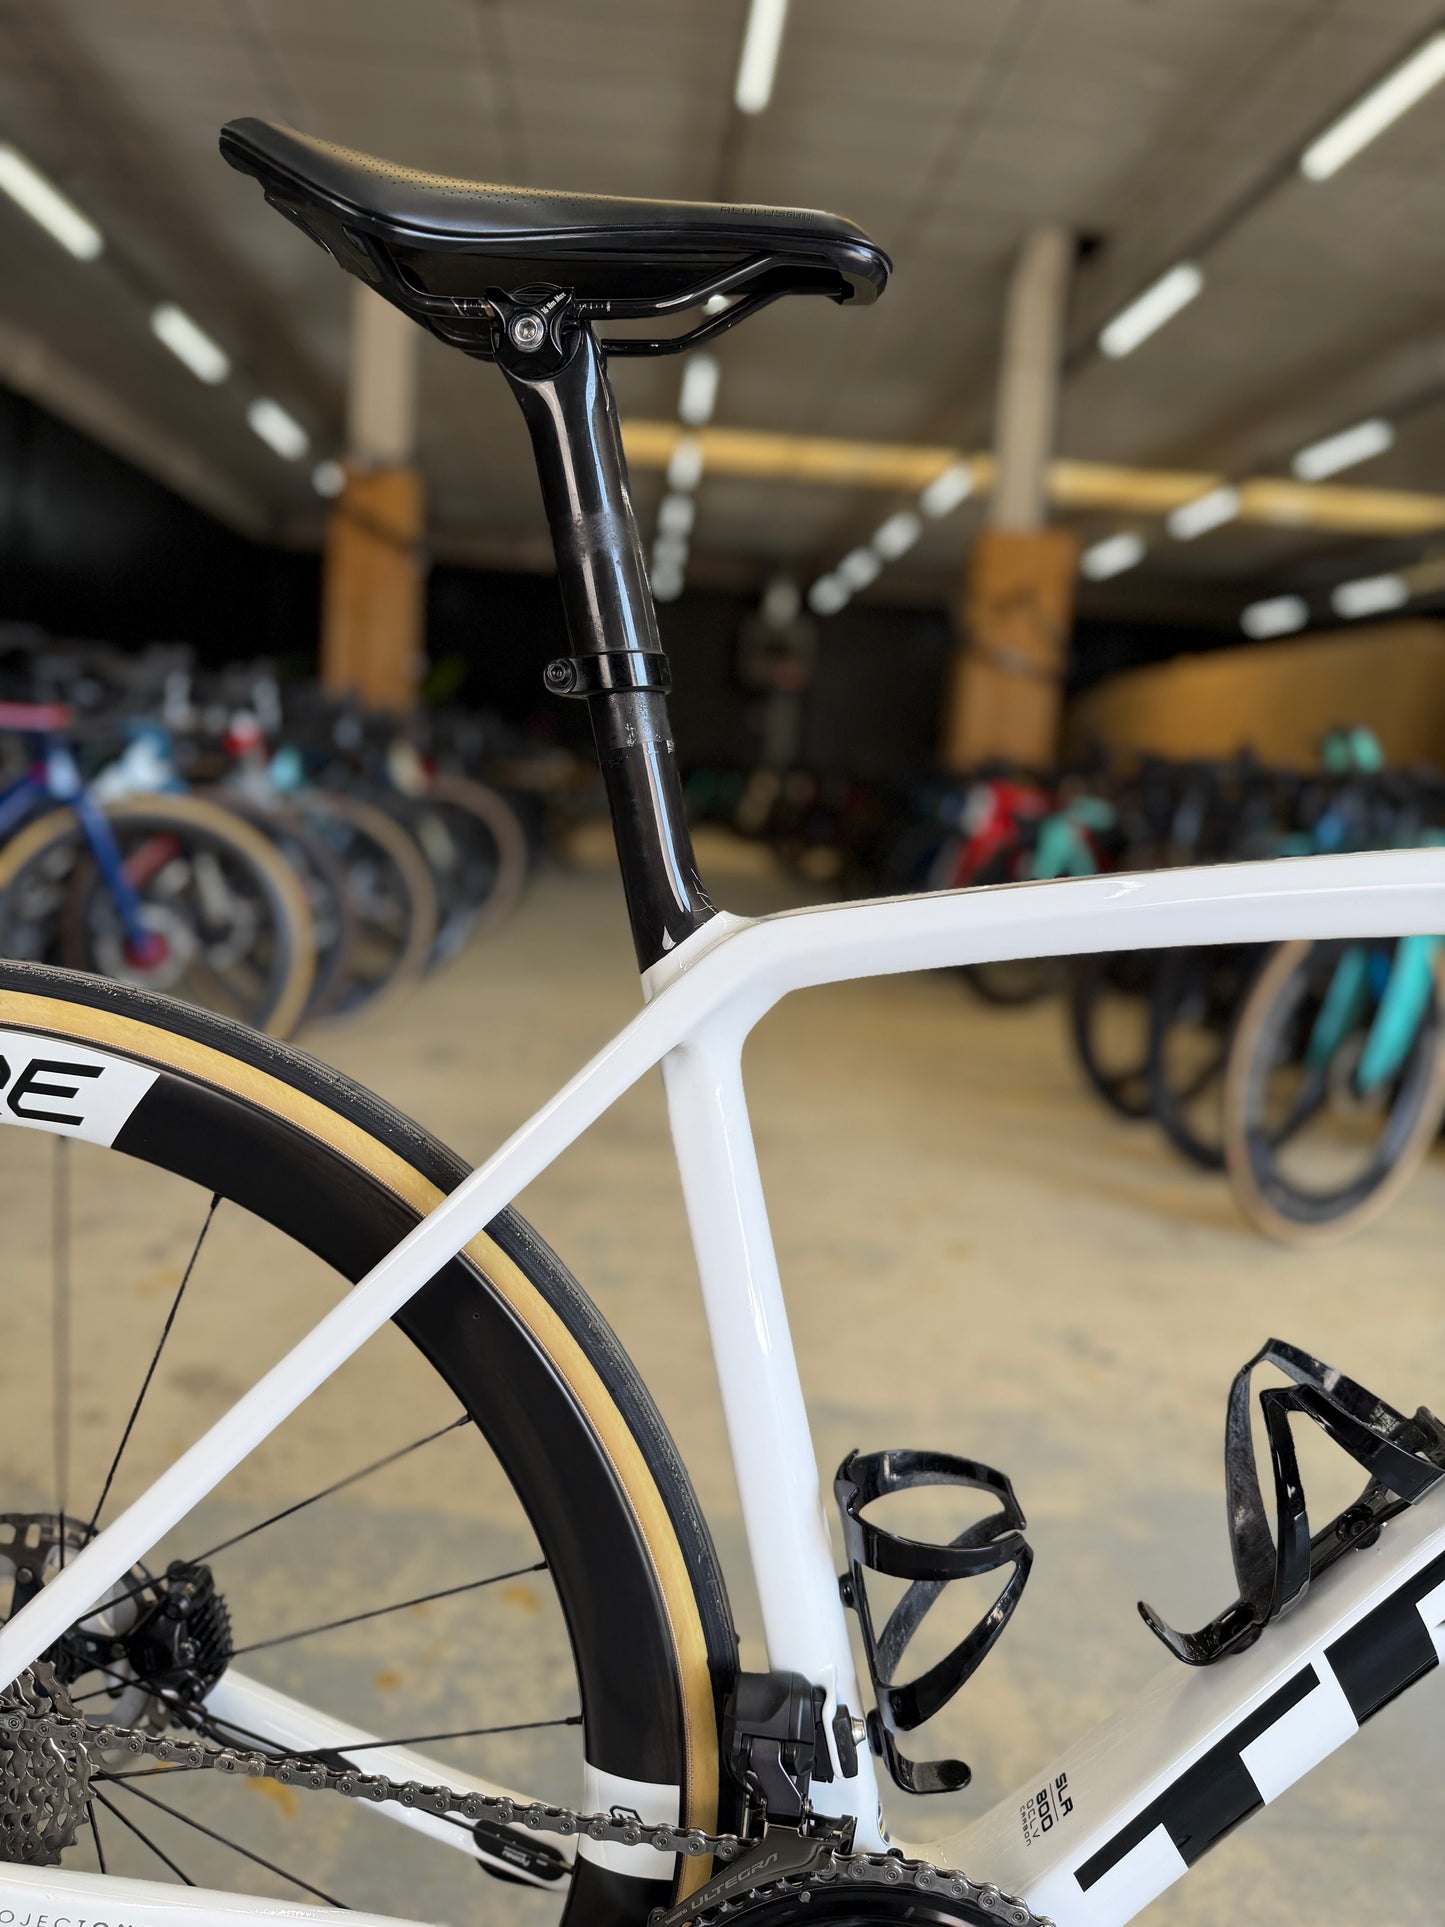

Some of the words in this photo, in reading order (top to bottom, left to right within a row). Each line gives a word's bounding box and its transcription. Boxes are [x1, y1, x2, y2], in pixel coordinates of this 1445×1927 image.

[1036, 1788, 1053, 1832] 800
[1055, 1772, 1074, 1817] SLR
[1026, 1798, 1041, 1839] OCLV
[690, 1851, 778, 1910] ULTEGRA
